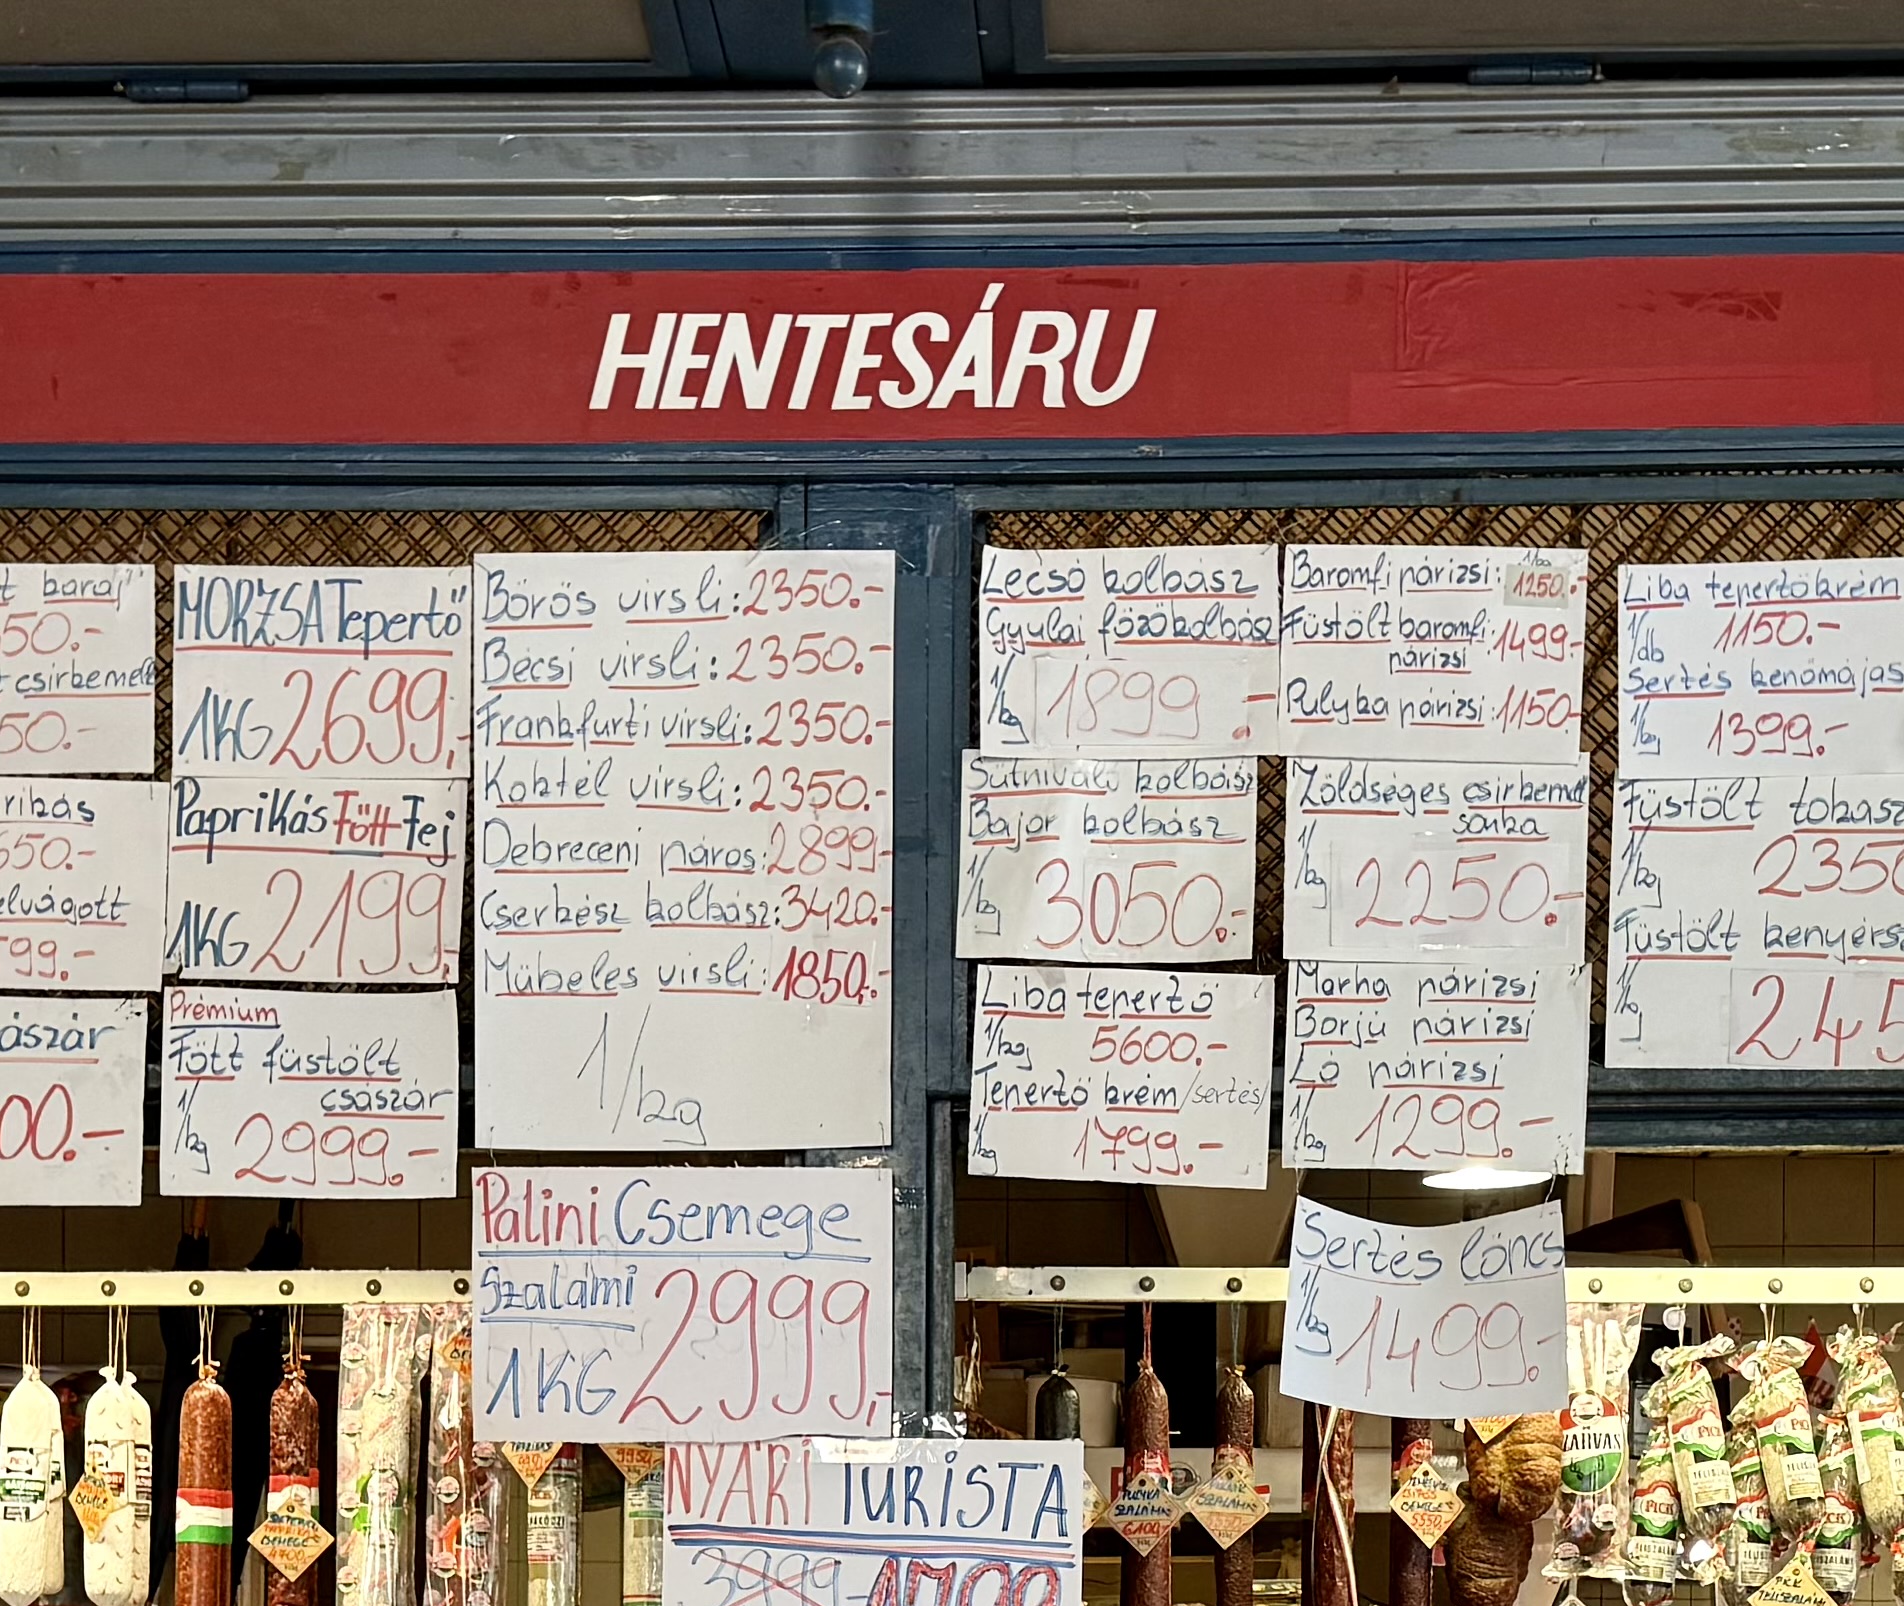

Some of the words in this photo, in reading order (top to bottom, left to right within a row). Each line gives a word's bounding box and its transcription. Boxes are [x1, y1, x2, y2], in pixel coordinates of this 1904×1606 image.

[589, 282, 1157, 410] HENTESÁRU
[178, 577, 324, 648] MORZSA
[1623, 573, 1692, 605] Liba
[483, 817, 643, 868] Debreceni
[970, 799, 1058, 851] Bajor
[981, 980, 1065, 1015] Liba
[1294, 963, 1392, 999] Marha
[169, 991, 279, 1025] Prémium
[476, 1170, 598, 1244] Palini
[613, 1178, 863, 1259] Csemege
[1296, 1212, 1442, 1281] Sertés
[665, 1439, 812, 1524] NYÁRI
